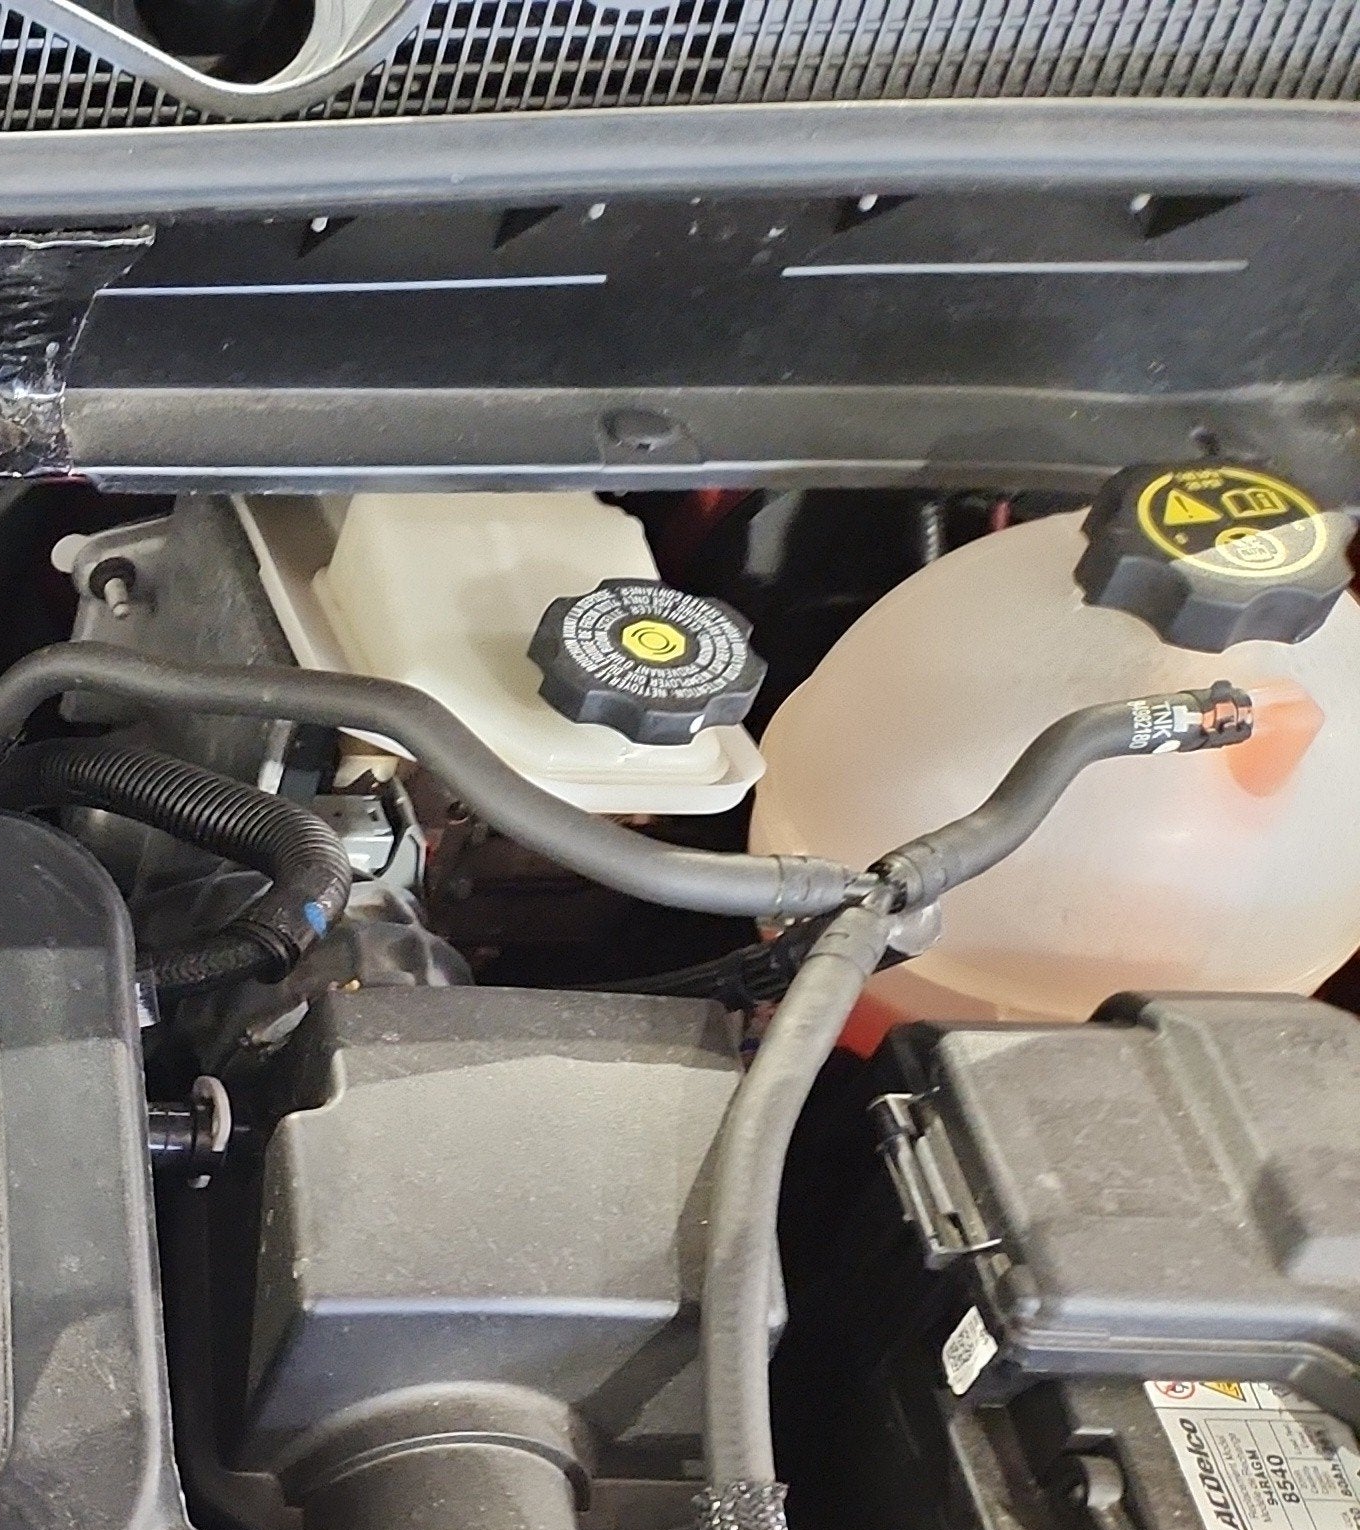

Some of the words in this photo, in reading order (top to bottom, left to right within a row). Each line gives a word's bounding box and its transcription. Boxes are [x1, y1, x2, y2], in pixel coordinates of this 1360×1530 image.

[1150, 701, 1173, 739] TNK
[1179, 1417, 1241, 1530] ACDelco
[1263, 1453, 1301, 1503] 8540
